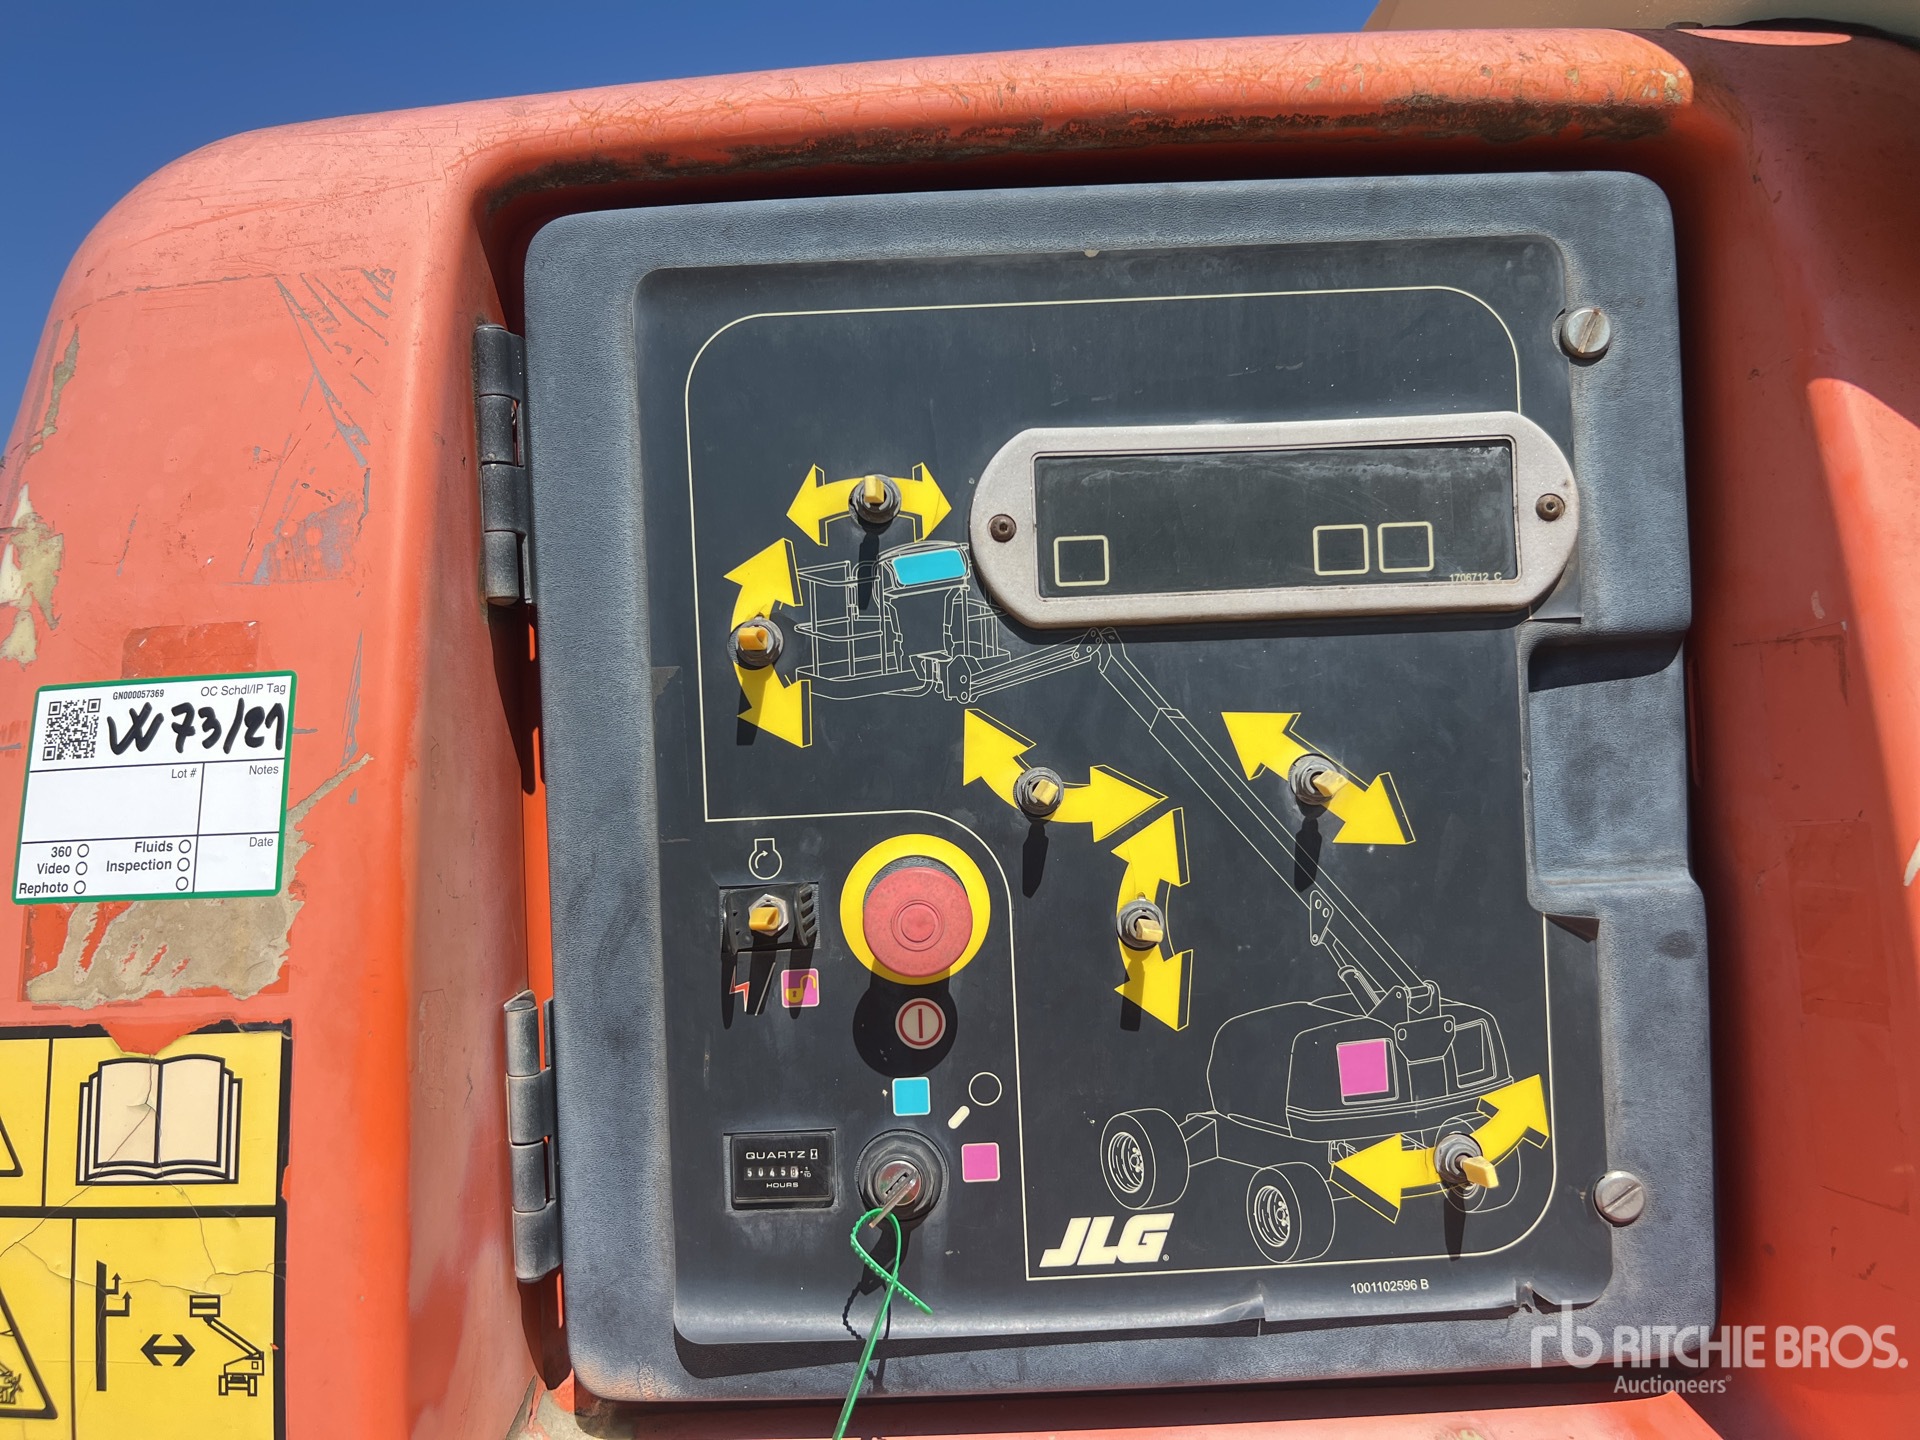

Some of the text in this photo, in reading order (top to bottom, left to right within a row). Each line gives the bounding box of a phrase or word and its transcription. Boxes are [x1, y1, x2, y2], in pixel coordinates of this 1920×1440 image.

[1449, 572, 1502, 582] 1706712 C
[112, 689, 165, 700] GN000057369
[200, 686, 219, 697] OC
[266, 683, 286, 696] Tag
[171, 768, 197, 779] Lot #
[249, 764, 279, 776] Notes
[134, 841, 173, 854] Fluids
[249, 836, 274, 847] Date
[50, 846, 72, 858] 360
[37, 863, 70, 875] Video
[106, 859, 172, 874] Inspection
[19, 881, 69, 895] Rephoto
[745, 1150, 806, 1160] QUARTZ
[1350, 1279, 1429, 1294] 1001102596 B
